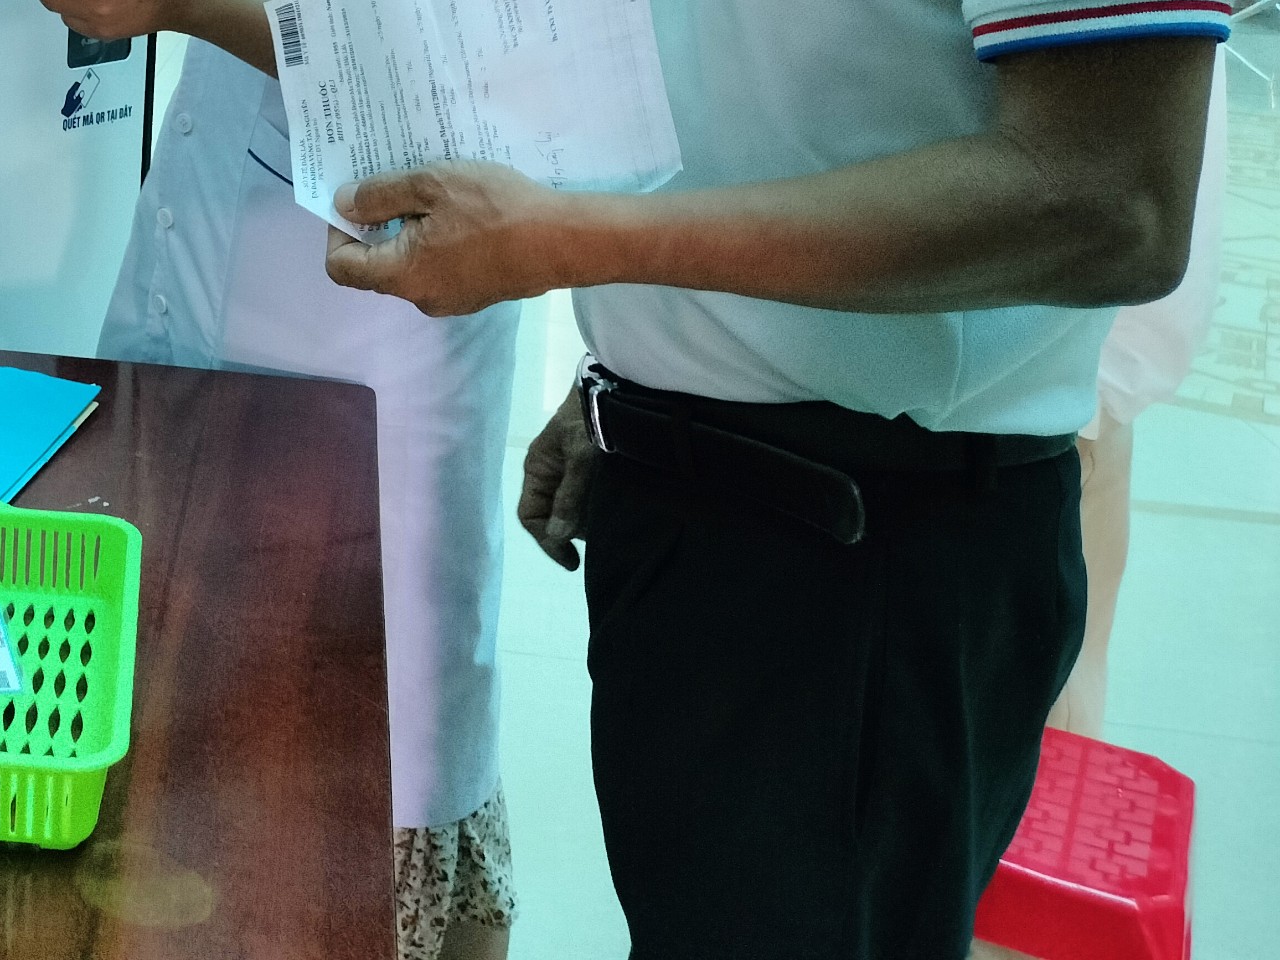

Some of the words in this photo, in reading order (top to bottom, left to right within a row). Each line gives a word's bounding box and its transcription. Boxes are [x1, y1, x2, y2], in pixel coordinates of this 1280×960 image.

[317, 80, 332, 117] THUỐC
[63, 115, 80, 131] QUÉT
[82, 112, 93, 126] MÃ
[96, 112, 105, 125] QR
[107, 109, 117, 123] TẠI
[119, 104, 132, 119] ĐÂY
[324, 121, 335, 143] ĐƠN
